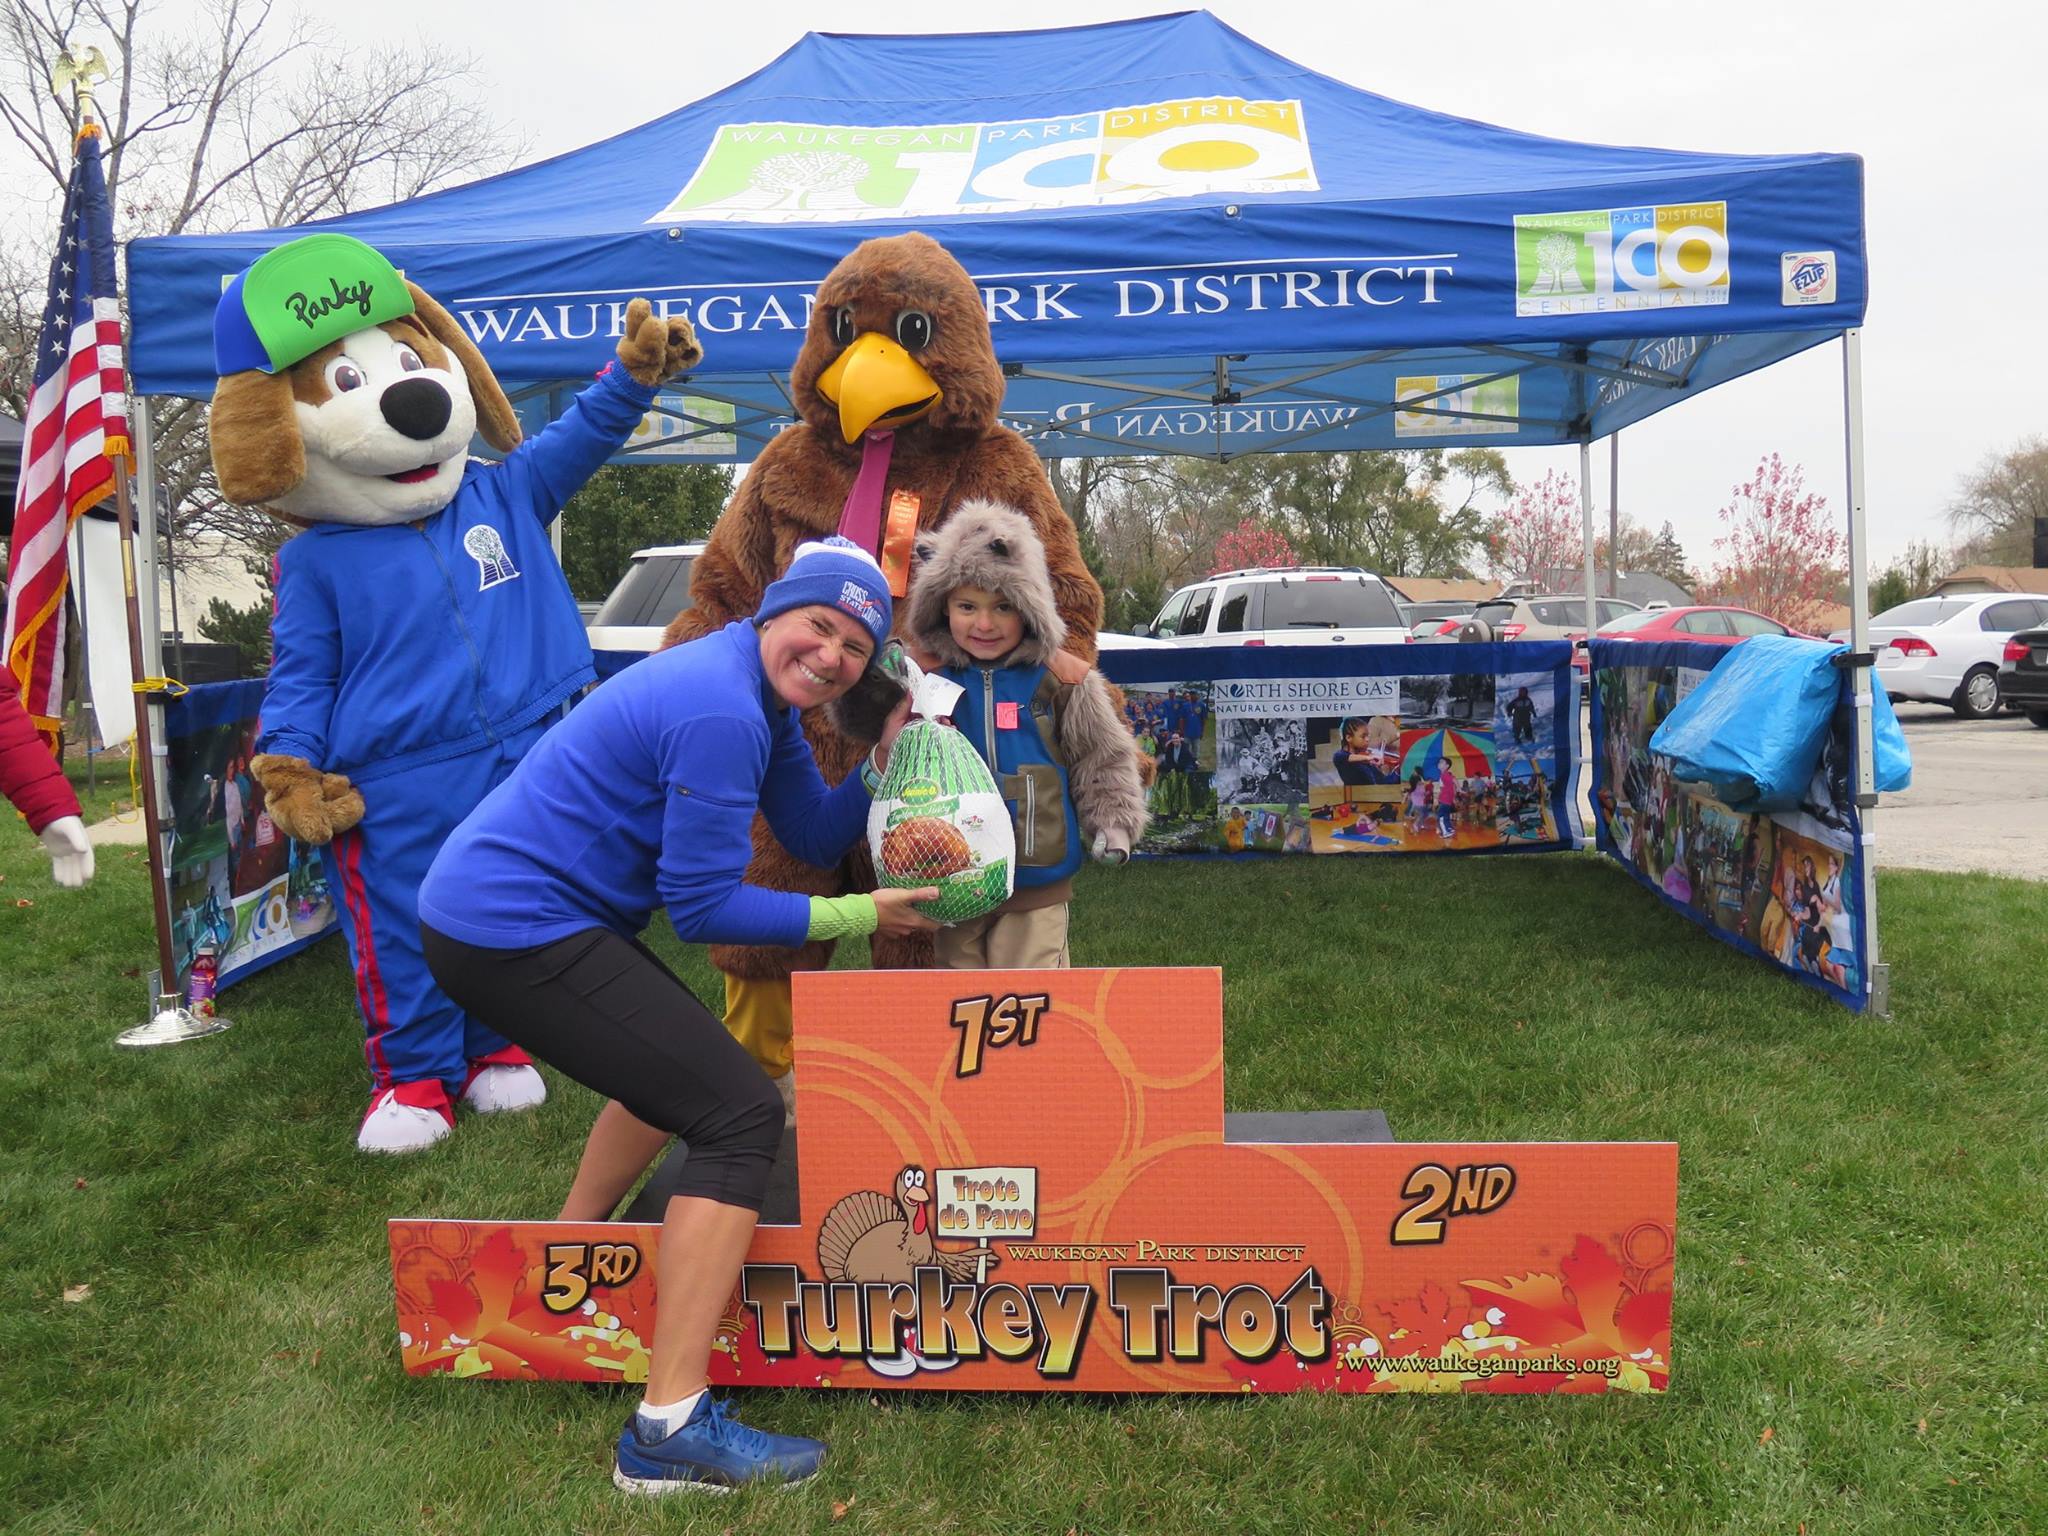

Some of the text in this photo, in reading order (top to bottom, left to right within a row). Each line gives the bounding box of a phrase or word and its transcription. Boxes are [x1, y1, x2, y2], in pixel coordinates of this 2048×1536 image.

[730, 103, 1290, 146] WAUKEGAN PARK DISTRICT
[1519, 206, 1723, 228] WAUKEGAN PARK DISTRICT
[285, 277, 374, 329] Parky
[983, 282, 1082, 323] RK
[1113, 266, 1454, 318] DISTRICT
[1519, 289, 1701, 315] CENTENNIAL
[1216, 683, 1281, 699] NORTH
[1288, 682, 1350, 698] SHORE
[1216, 701, 1354, 713] NATURAL GAS DELIVERY
[950, 993, 1049, 1079] 1ST
[952, 1175, 1020, 1202] Trote
[938, 1203, 1034, 1230] de Pavo
[1391, 1162, 1516, 1245] 2ND
[1007, 1246, 1129, 1262] WAUKEGAN
[1205, 1246, 1306, 1262] DISTRICT
[541, 1242, 641, 1315] 3RD
[741, 1264, 1328, 1375] Turkey Trot
[1345, 1353, 1620, 1377] www.waukeganparks.org
